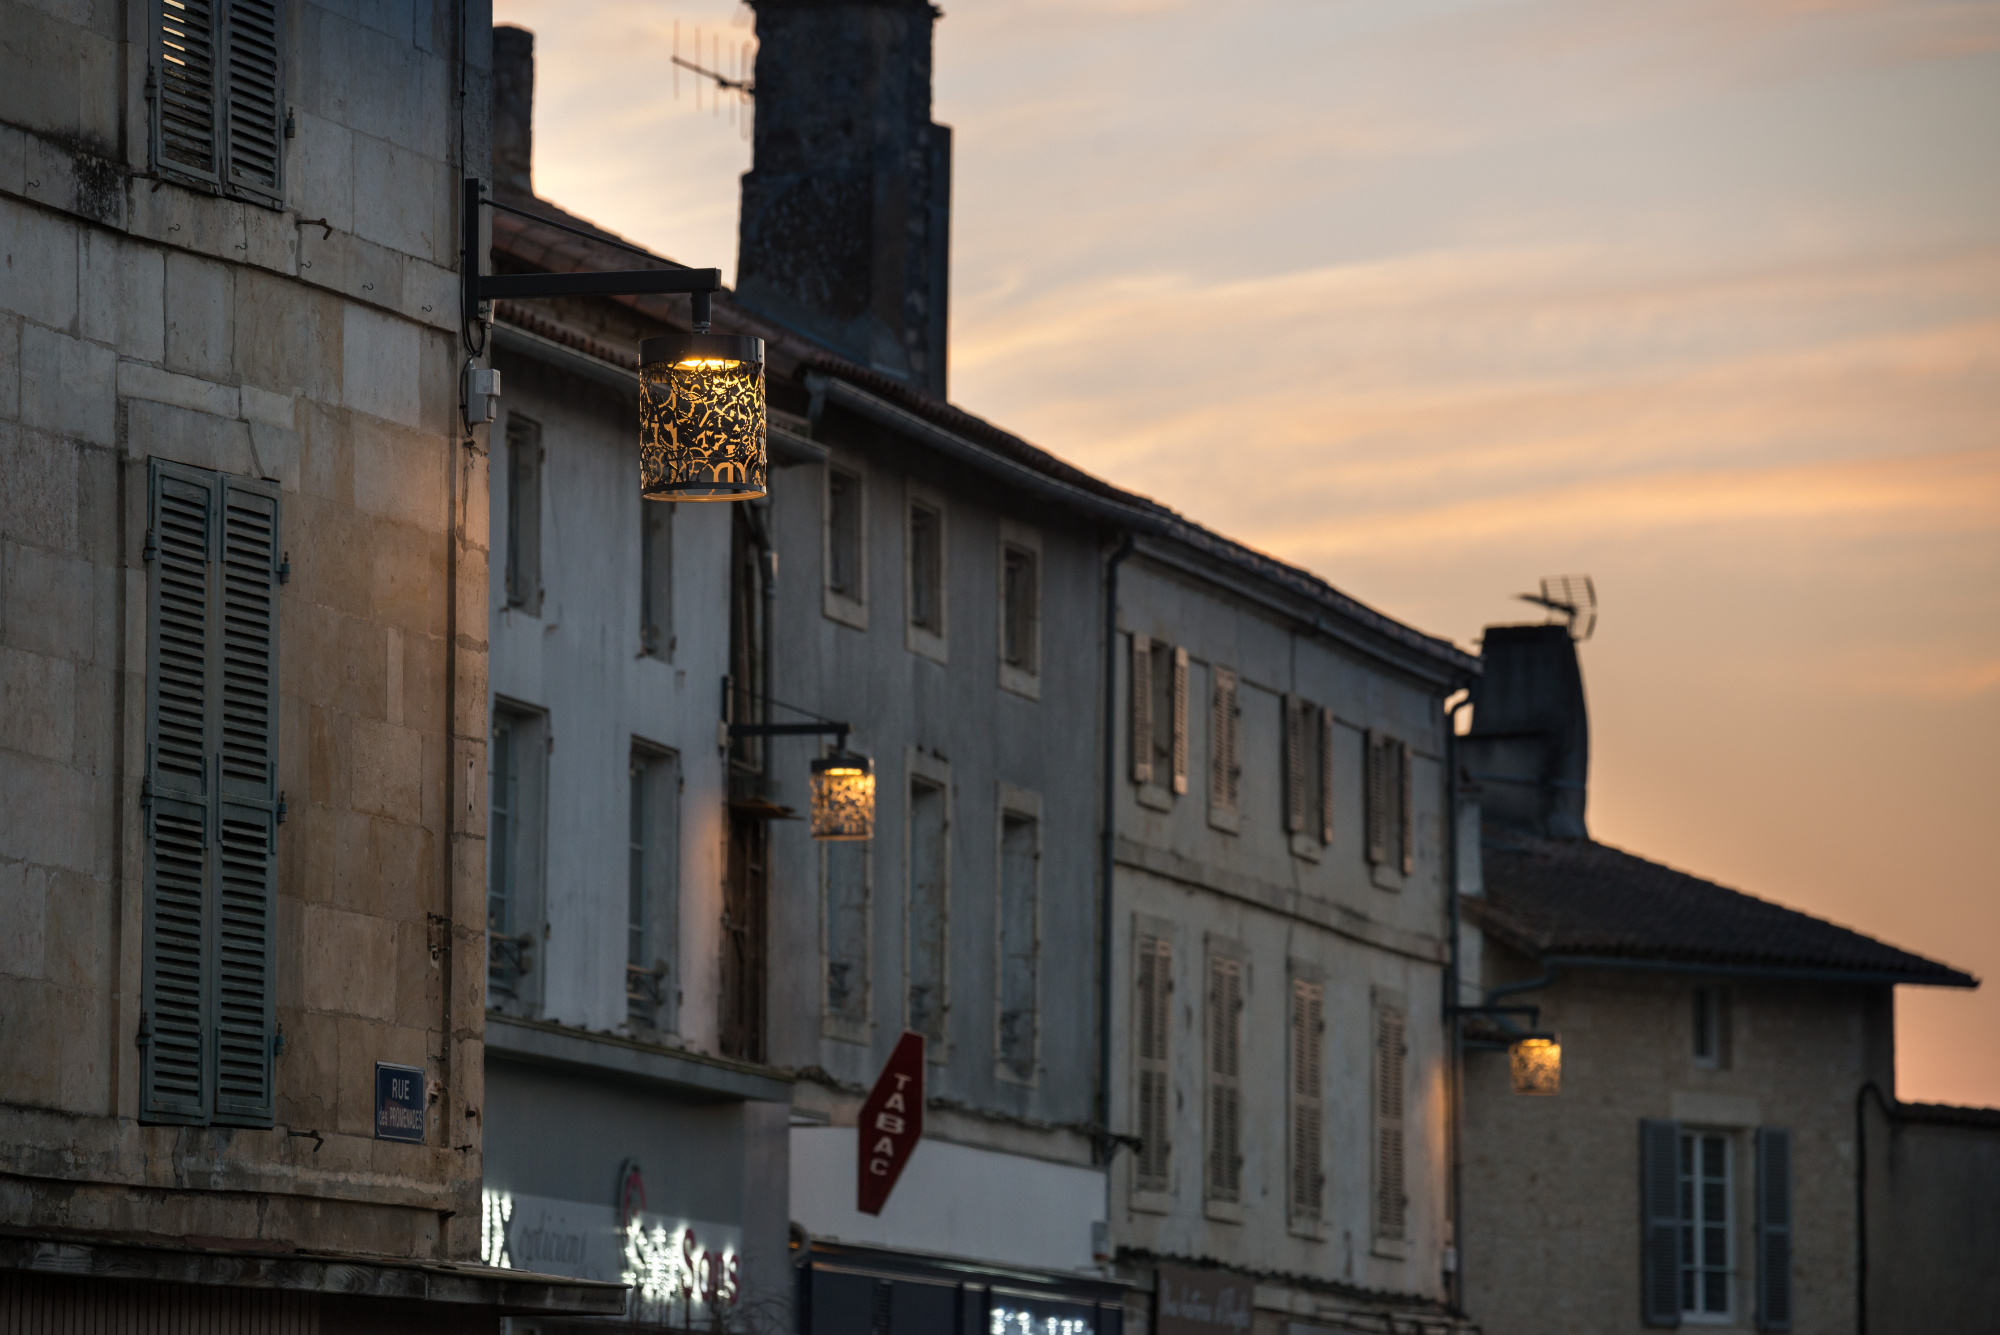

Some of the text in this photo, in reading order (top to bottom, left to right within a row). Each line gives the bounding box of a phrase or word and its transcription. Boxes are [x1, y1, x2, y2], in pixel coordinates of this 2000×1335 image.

[391, 1078, 410, 1100] RUE
[379, 1106, 423, 1131] des PROMENADES
[869, 1072, 912, 1177] TABAC
